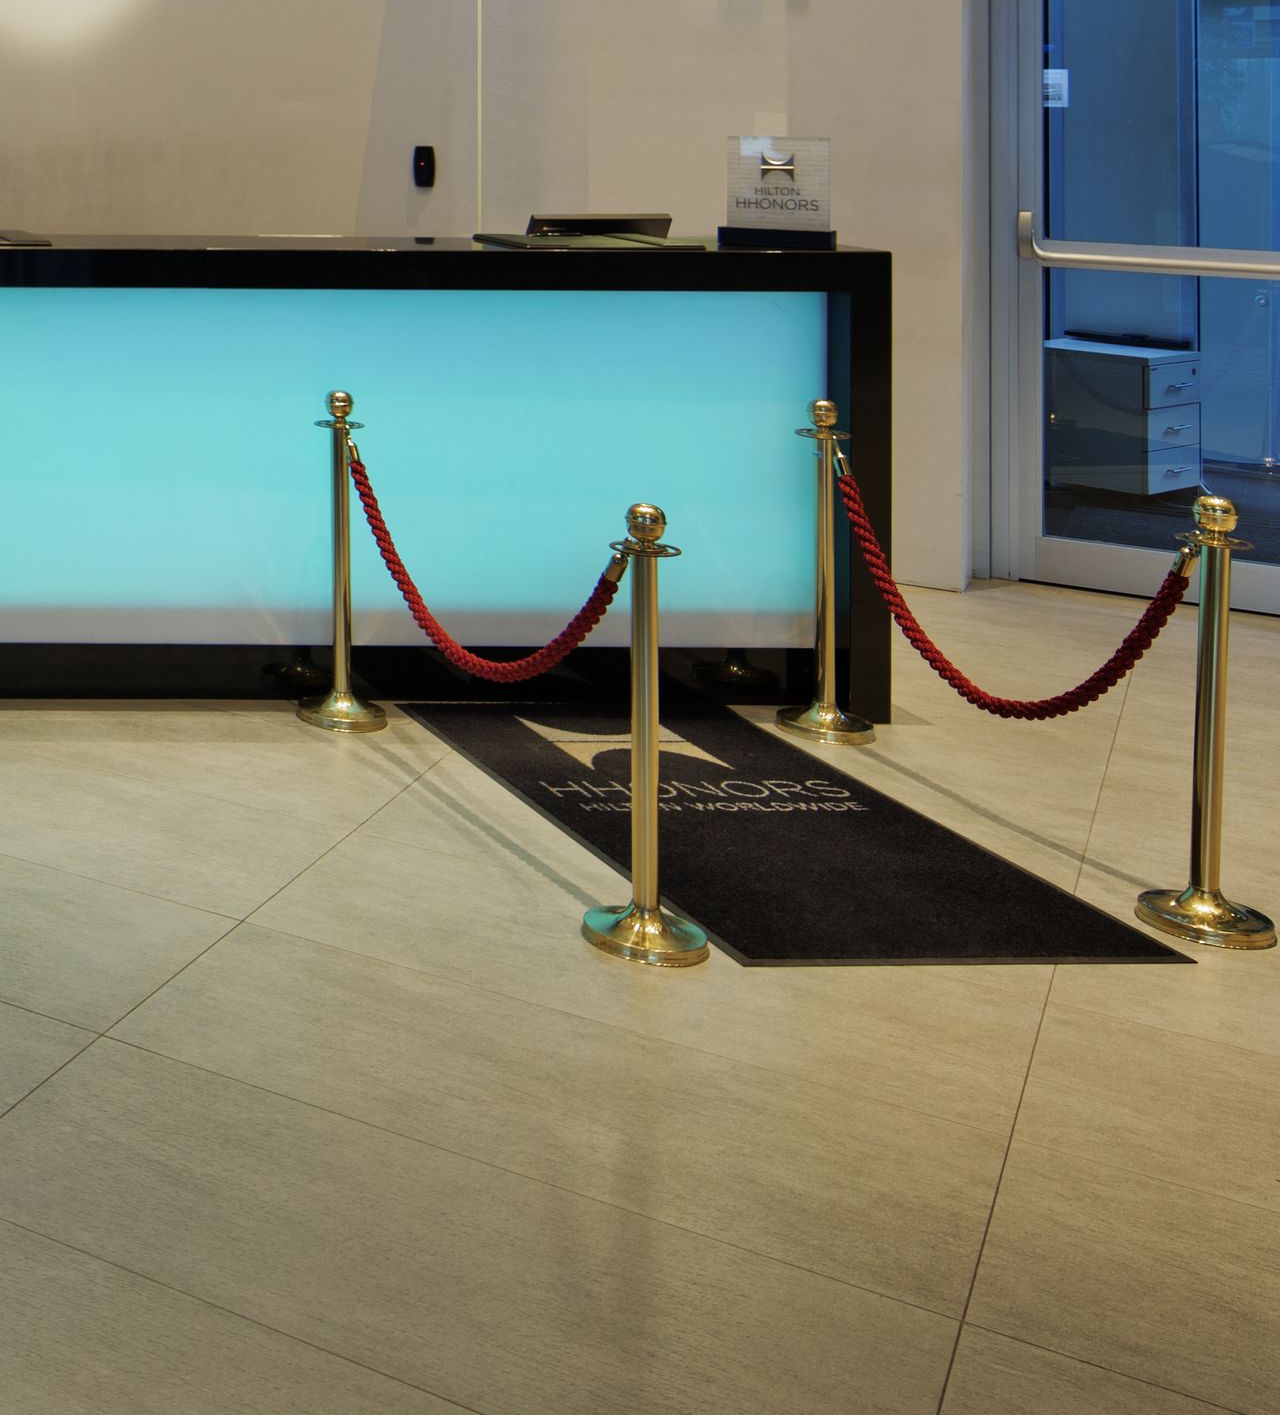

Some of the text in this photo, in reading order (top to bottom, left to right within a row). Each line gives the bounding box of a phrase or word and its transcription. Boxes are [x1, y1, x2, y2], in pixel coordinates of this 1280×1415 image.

[754, 187, 801, 196] HILTON
[736, 198, 820, 211] HHONORS
[579, 801, 870, 812] HILTN WORLDWIDE
